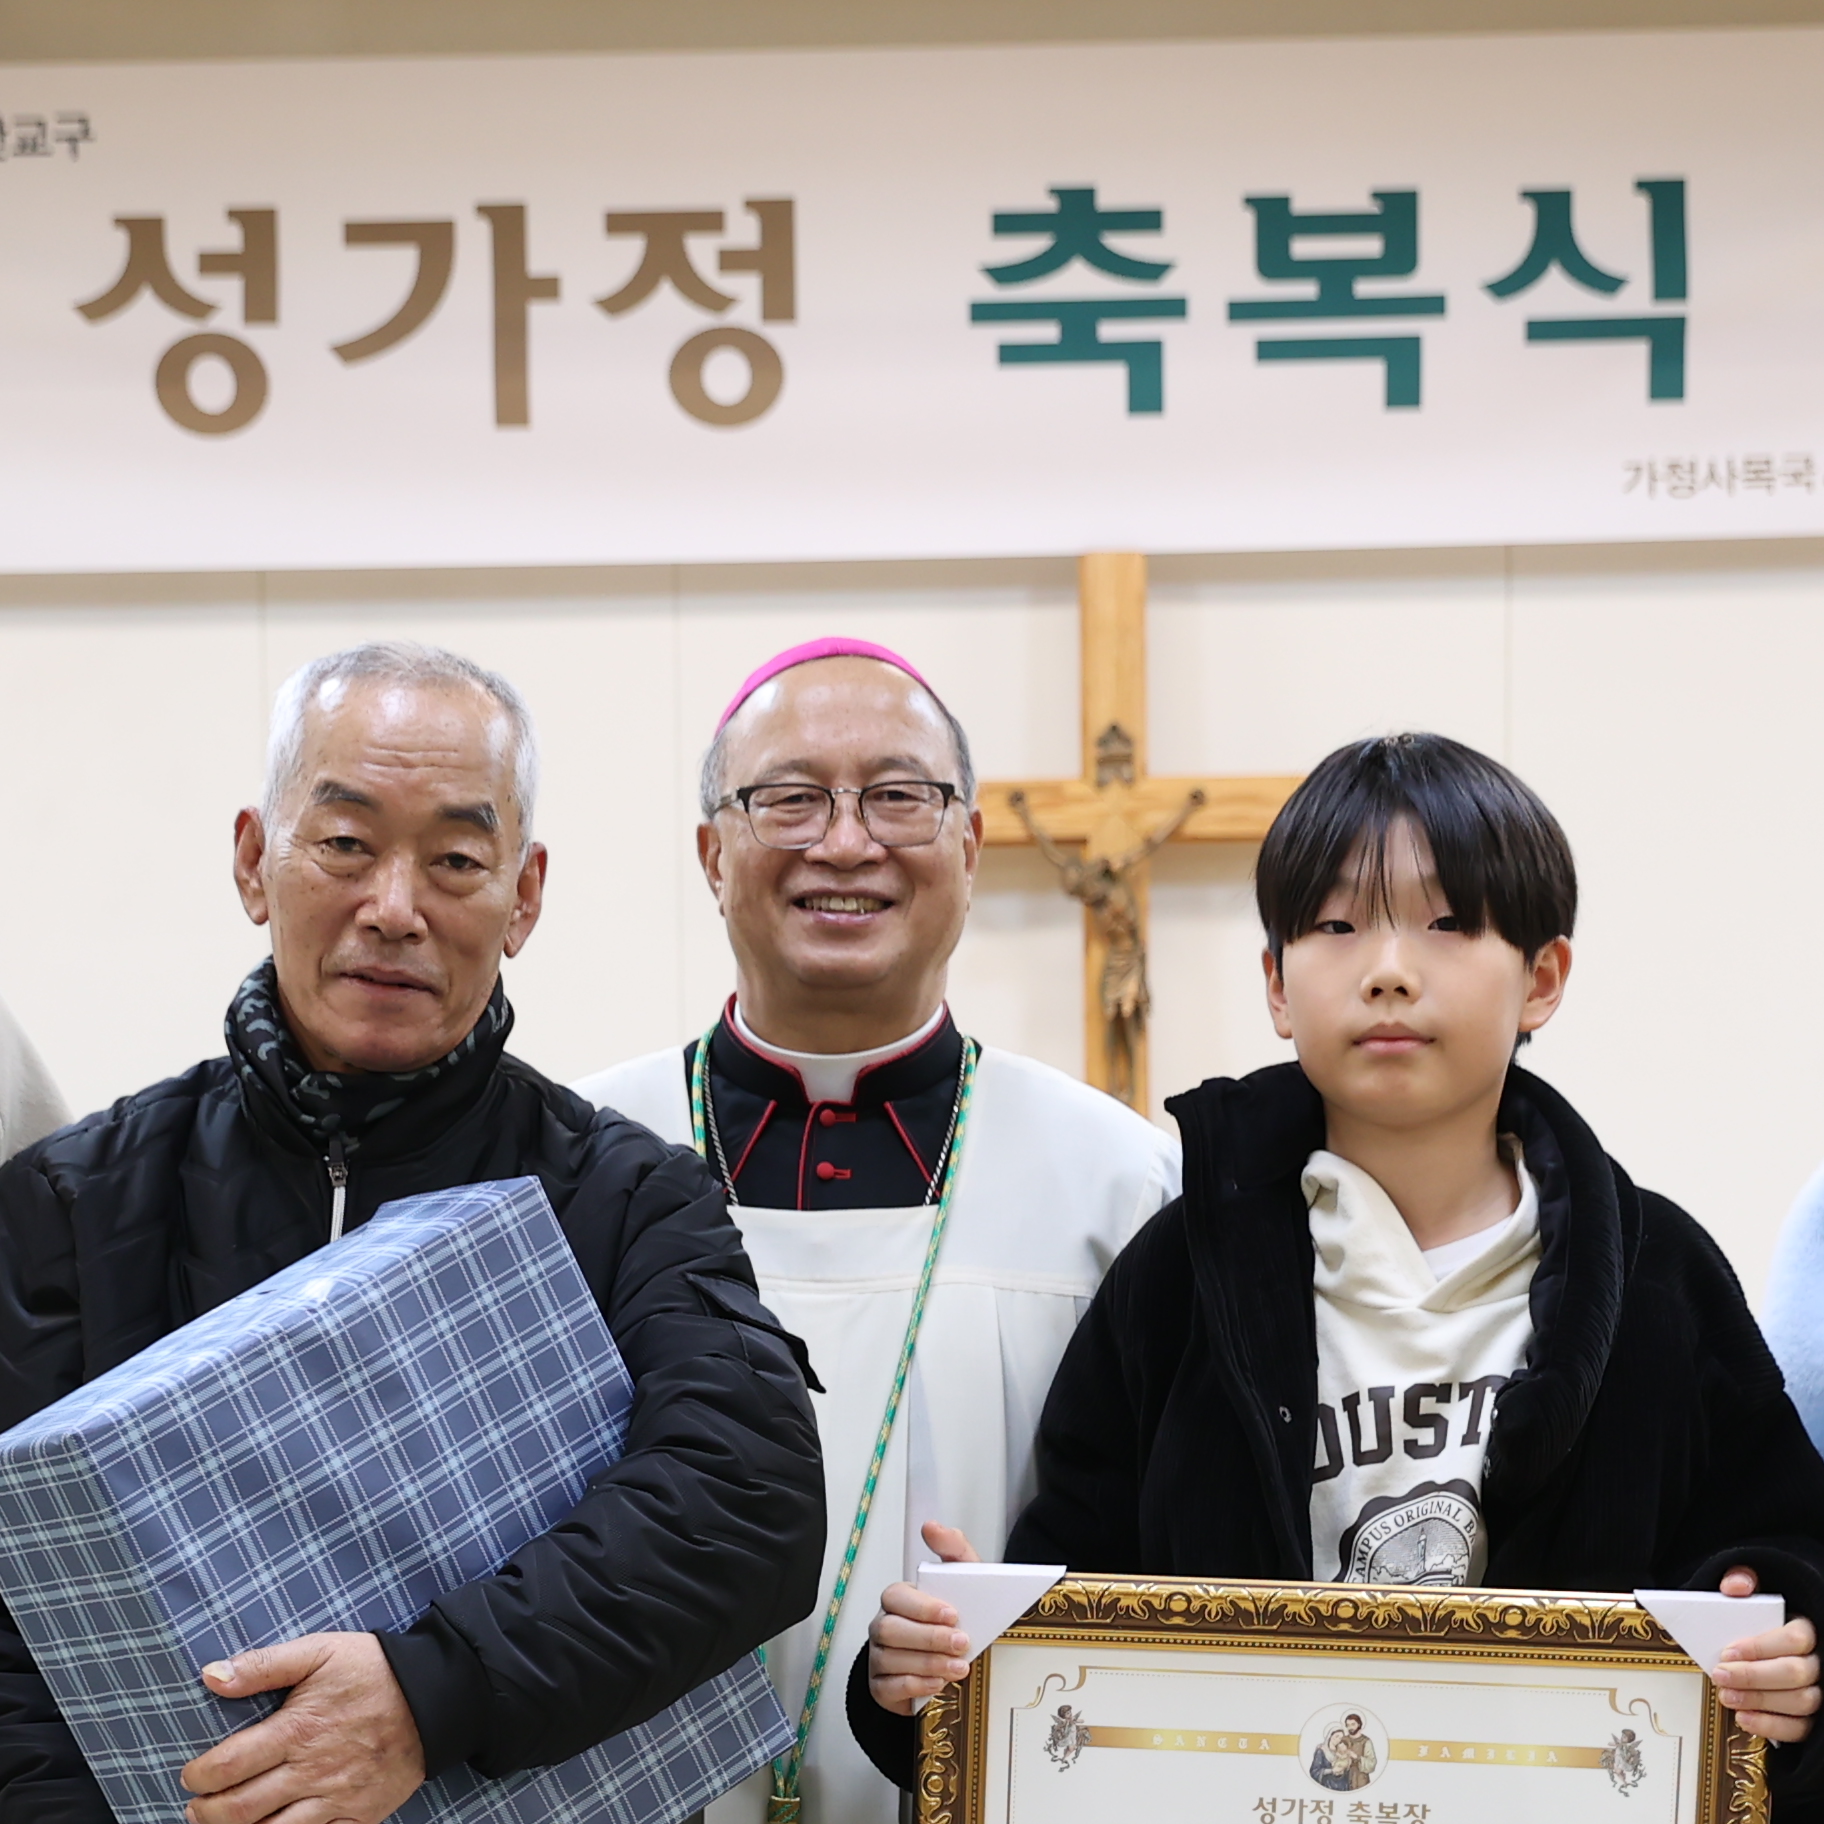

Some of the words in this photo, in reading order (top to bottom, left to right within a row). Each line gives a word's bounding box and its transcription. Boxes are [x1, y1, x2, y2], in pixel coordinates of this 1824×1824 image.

[73, 194, 801, 437] 성가정
[970, 175, 1688, 416] 축복식
[1393, 1500, 1463, 1527] ORIGINAL
